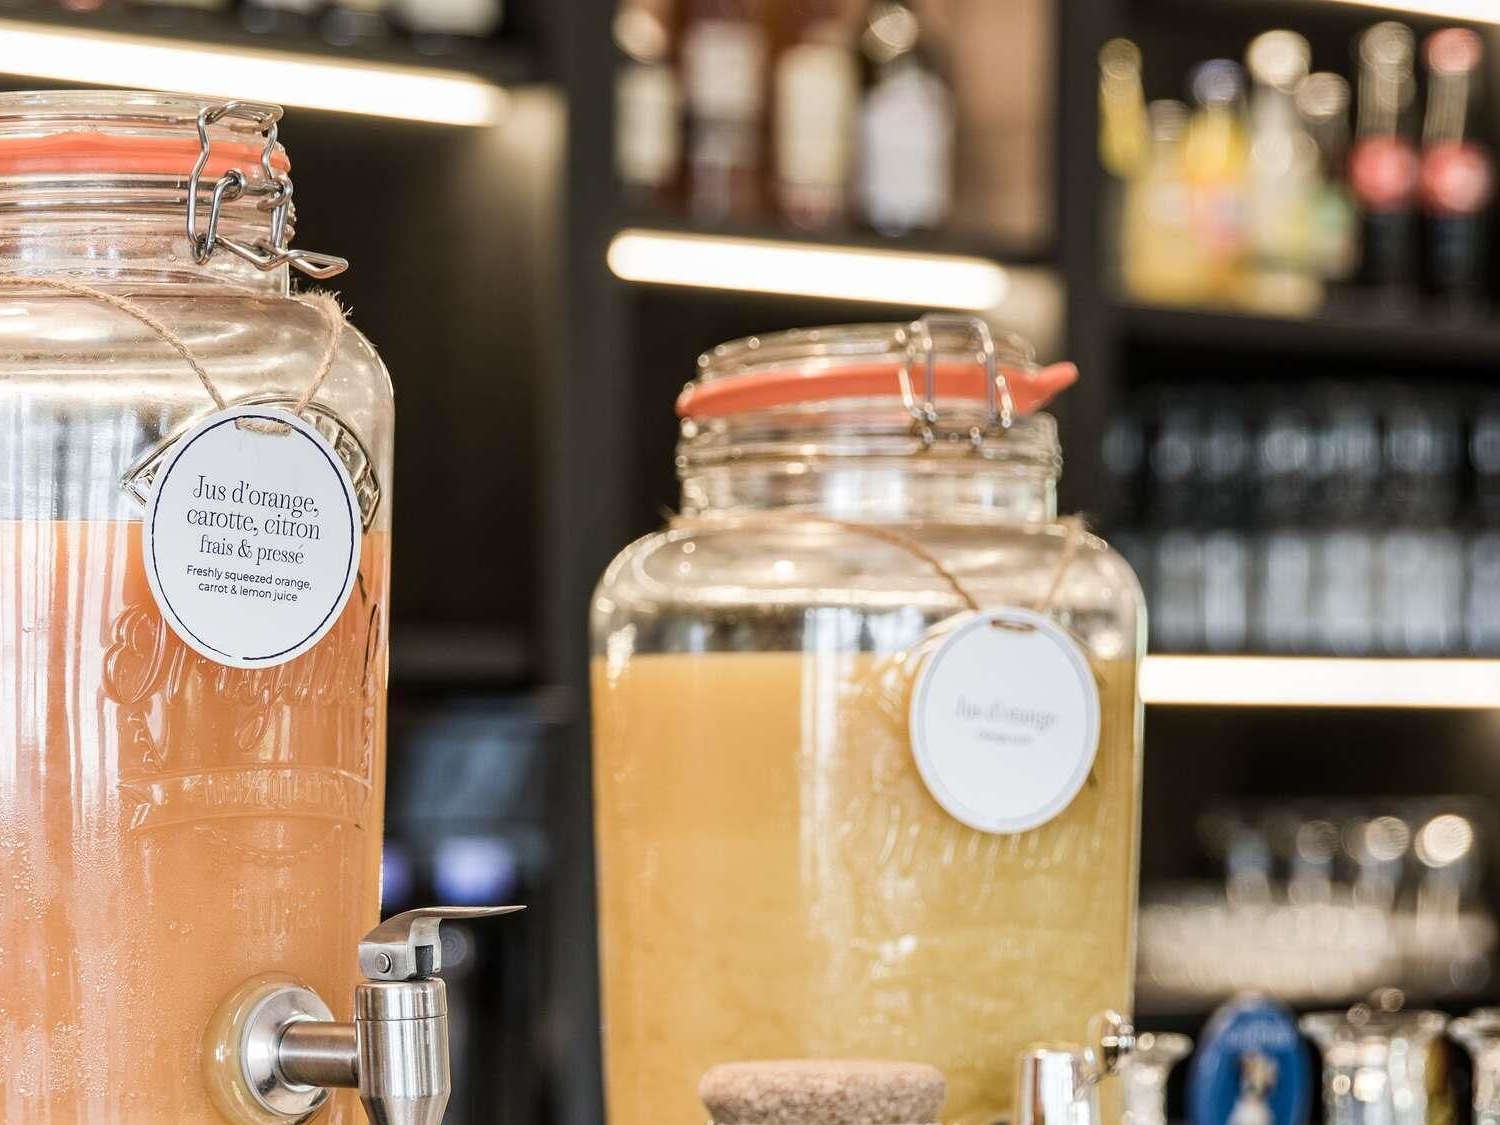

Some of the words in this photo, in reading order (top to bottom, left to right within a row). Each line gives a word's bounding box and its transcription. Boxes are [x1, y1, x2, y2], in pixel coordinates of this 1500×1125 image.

[193, 475, 226, 502] Jus
[232, 481, 320, 518] d'orange,
[186, 507, 259, 536] carotte,
[264, 514, 321, 540] citron
[199, 534, 234, 557] frais
[238, 539, 253, 558] &
[255, 544, 305, 566] pressé
[186, 565, 223, 581] Freshly
[224, 569, 273, 585] squeezed
[275, 577, 312, 591] orange,
[198, 582, 228, 594] carrot
[230, 585, 238, 595] &
[239, 585, 271, 599] lemon
[272, 588, 298, 602] juice
